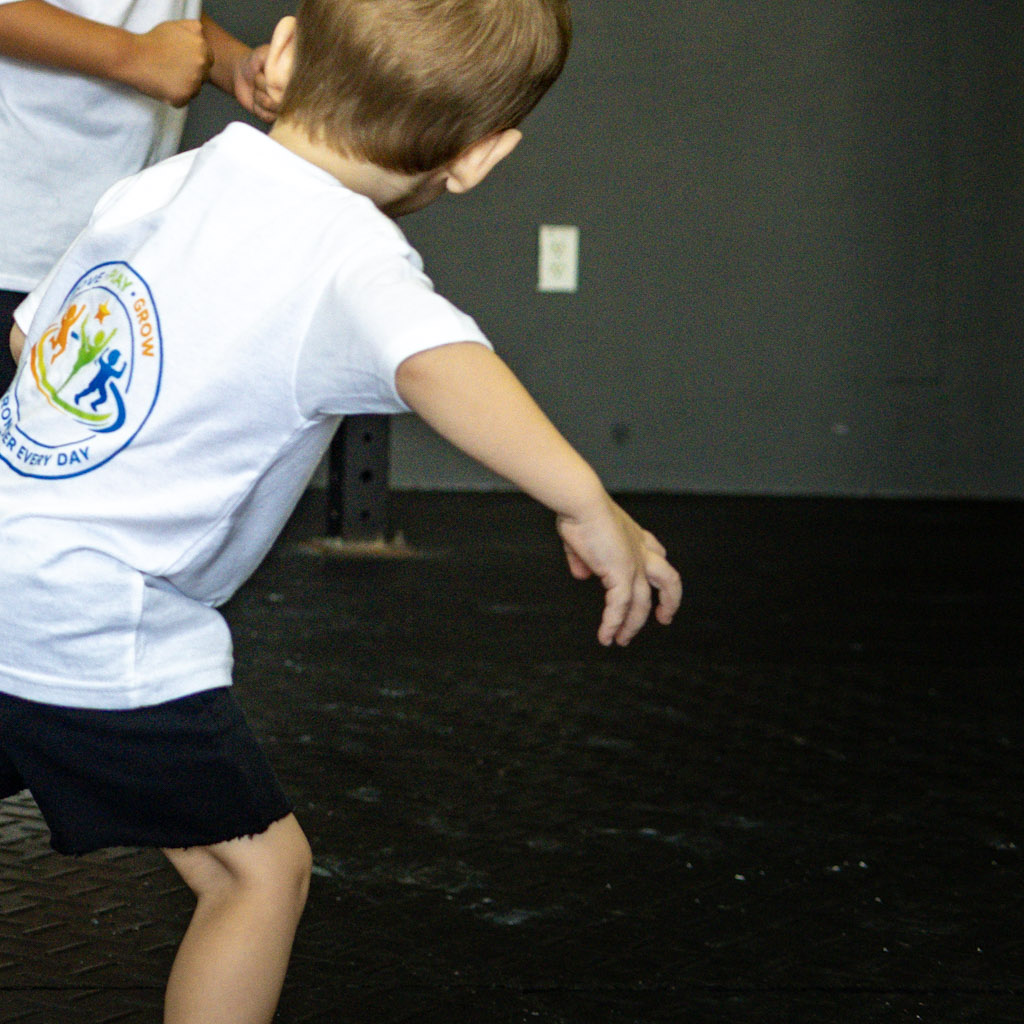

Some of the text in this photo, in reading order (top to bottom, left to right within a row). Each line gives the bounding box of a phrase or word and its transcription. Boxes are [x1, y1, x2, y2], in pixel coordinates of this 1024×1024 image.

[133, 297, 155, 357] GROW
[16, 445, 53, 466] EVERY
[57, 446, 90, 466] DAY
